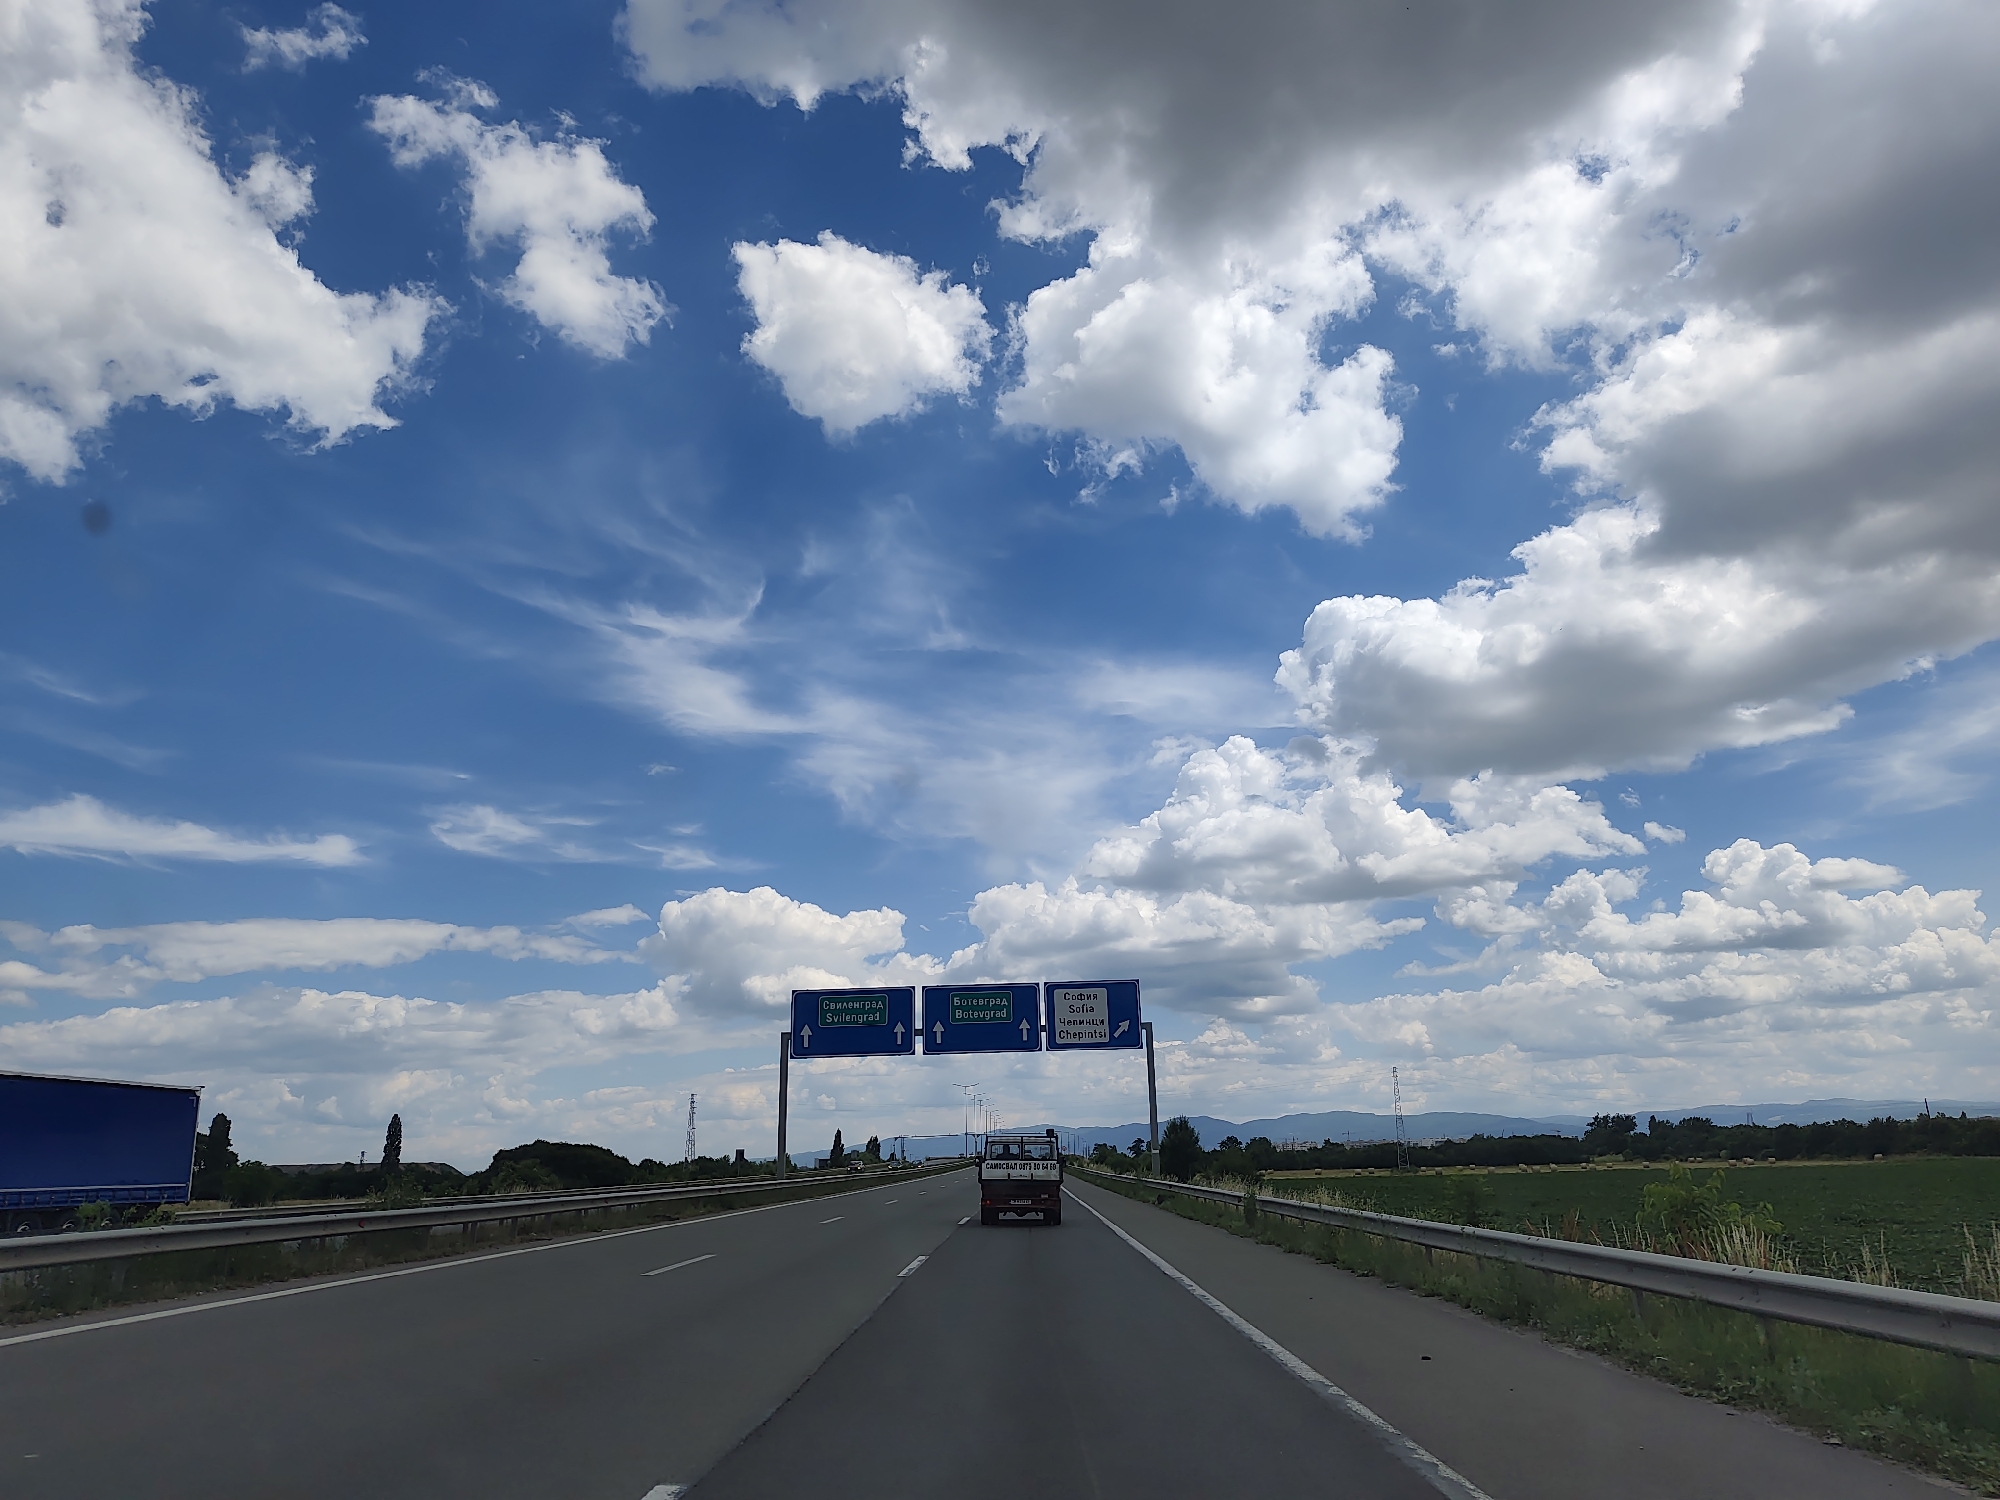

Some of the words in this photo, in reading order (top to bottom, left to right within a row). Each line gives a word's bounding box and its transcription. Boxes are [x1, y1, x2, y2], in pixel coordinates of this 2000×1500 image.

[953, 997, 1008, 1007] Ботевград
[1063, 992, 1098, 1002] София
[823, 1000, 884, 1010] Свиленград
[1068, 1003, 1095, 1014] Sofia
[826, 1012, 880, 1023] Svilengrad
[955, 1008, 1007, 1020] Botevgrad
[1059, 1017, 1105, 1027] Чепинци
[1058, 1029, 1107, 1041] Chepintsi
